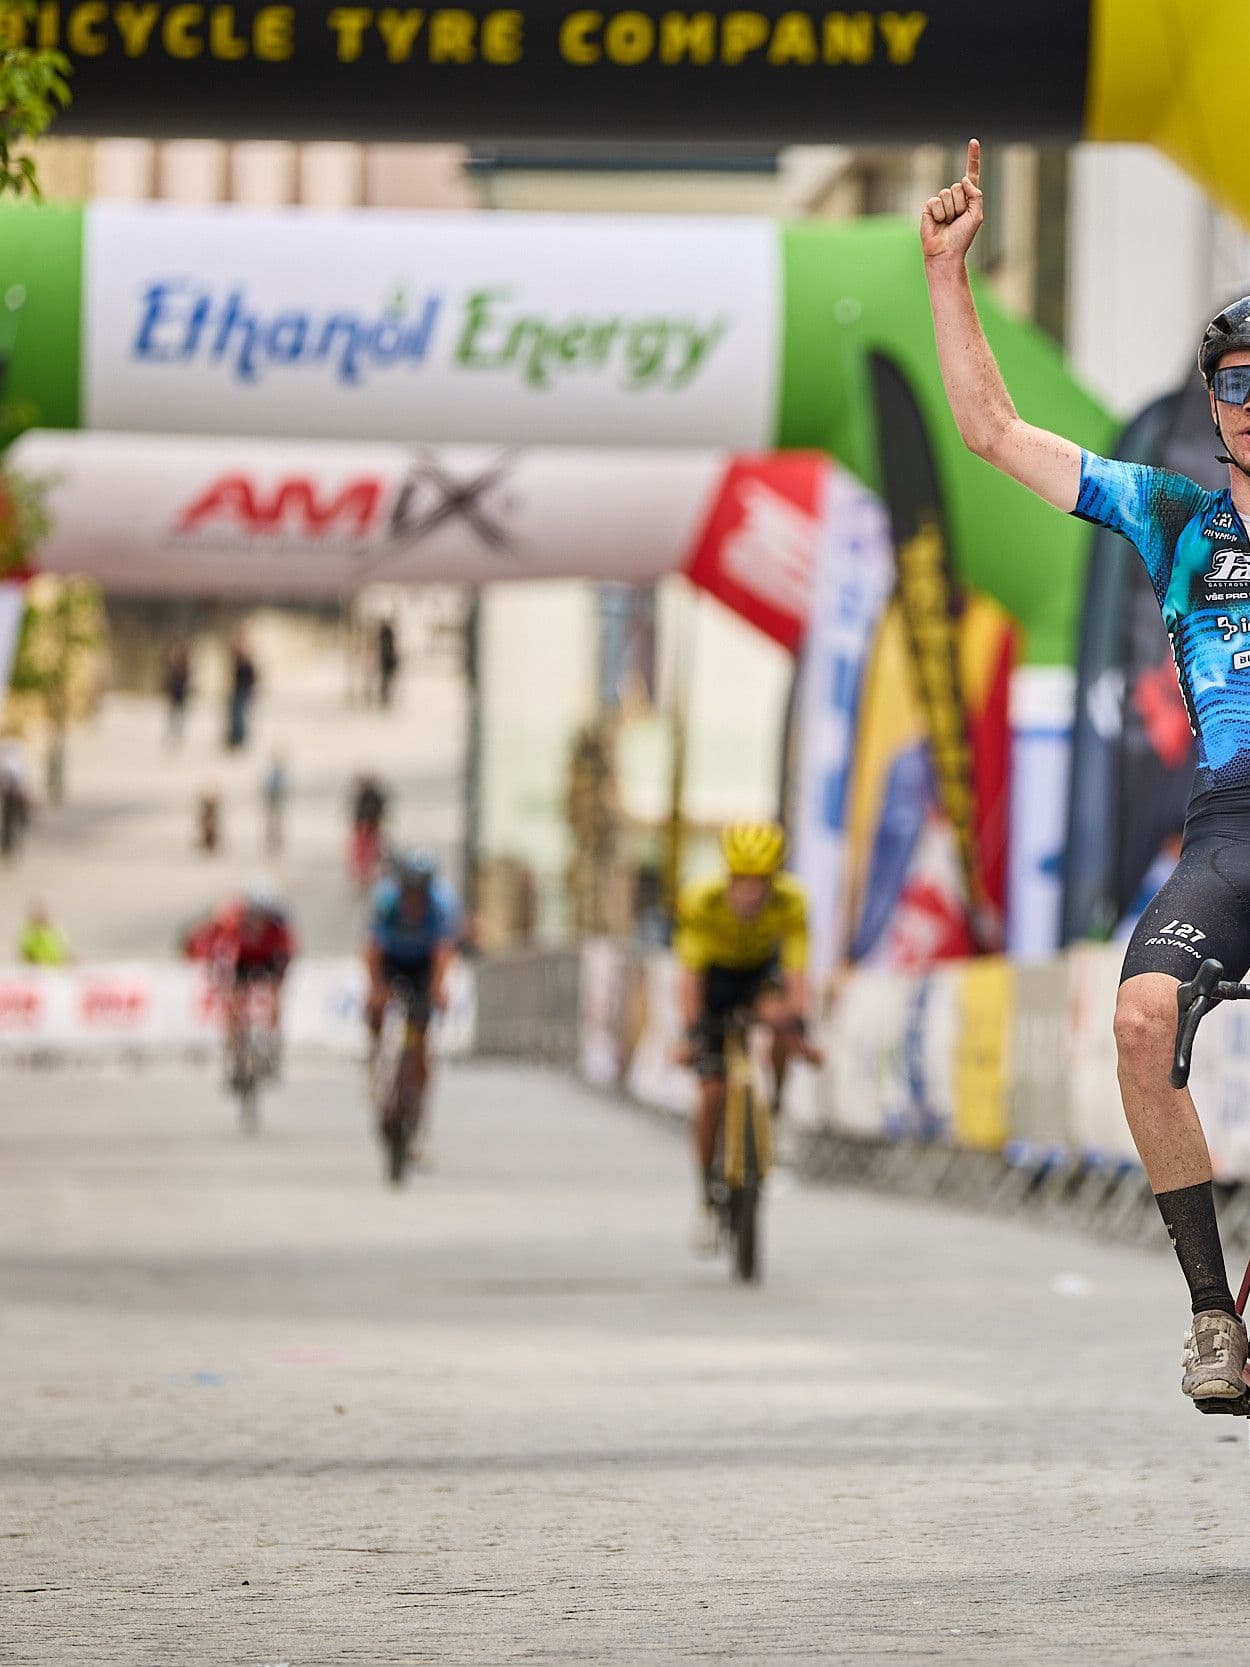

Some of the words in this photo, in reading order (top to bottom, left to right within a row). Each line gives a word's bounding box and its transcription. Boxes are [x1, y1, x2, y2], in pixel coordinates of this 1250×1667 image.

[328, 7, 525, 64] TYRE
[558, 10, 929, 66] COMPANY
[132, 277, 442, 387] Ethanol
[454, 288, 730, 392] Energy
[1205, 592, 1224, 601] VŠE
[1160, 919, 1206, 943] L27
[1144, 937, 1202, 959] RAYMON
